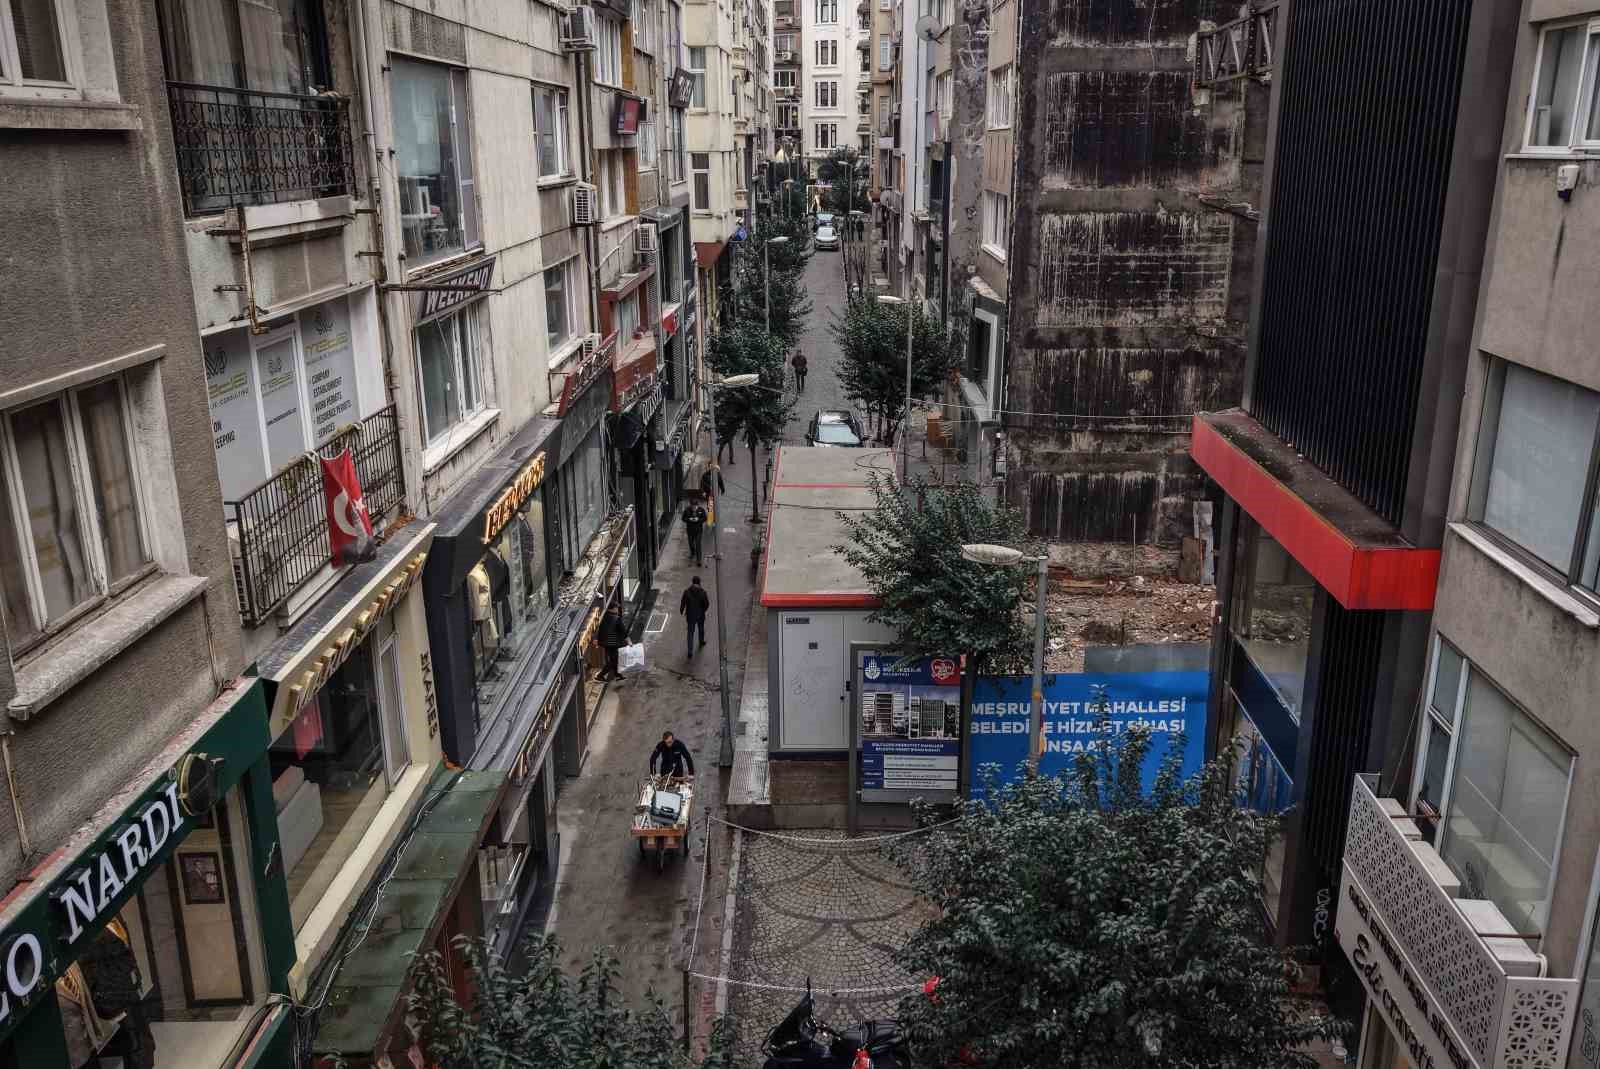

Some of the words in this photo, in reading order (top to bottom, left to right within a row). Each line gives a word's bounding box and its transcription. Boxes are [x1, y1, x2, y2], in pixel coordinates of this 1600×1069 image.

[971, 698, 1080, 717] MEŞRUİYET
[970, 718, 1054, 735] BELEDİE
[60, 782, 185, 944] NARDI
